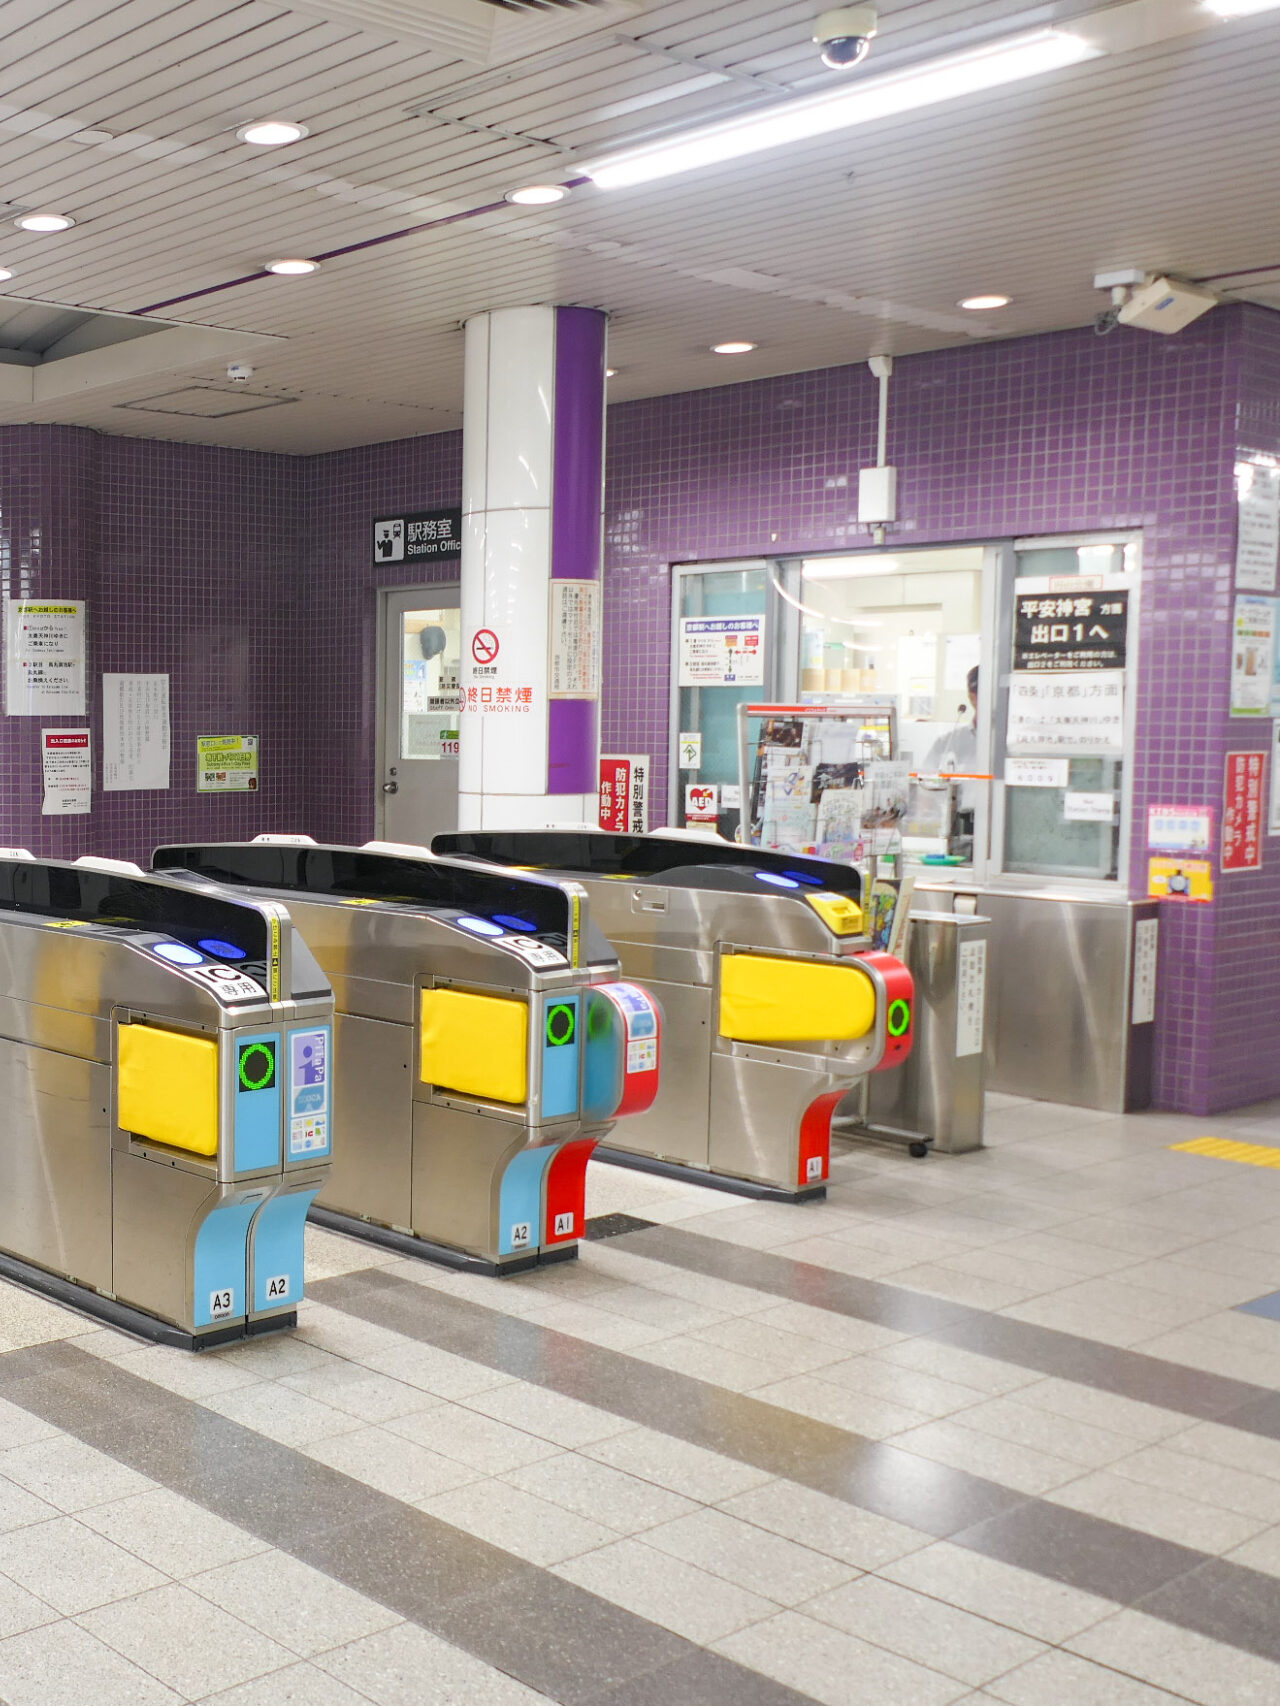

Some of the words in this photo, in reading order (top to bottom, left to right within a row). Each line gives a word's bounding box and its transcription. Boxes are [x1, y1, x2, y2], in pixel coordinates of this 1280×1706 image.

[407, 518, 452, 542] 駅務室
[408, 542, 438, 555] Station
[1020, 598, 1093, 618] 平安神宮
[1100, 603, 1122, 615] 方面
[1030, 624, 1109, 644] 出口1へ
[468, 687, 532, 704] 終日禁煙
[468, 704, 478, 713] NO
[484, 704, 530, 713] SMOKING
[442, 742, 460, 753] 119
[600, 781, 612, 820] 作動中
[614, 767, 626, 832] 防犯カメラ
[632, 767, 644, 832] 特別警戒
[193, 968, 242, 983] IC
[222, 981, 257, 996] 専用
[314, 1036, 325, 1083] PiTaPa
[557, 1216, 570, 1232] A1
[514, 1226, 528, 1242] A2
[268, 1278, 286, 1296] A2
[213, 1292, 230, 1310] A3
